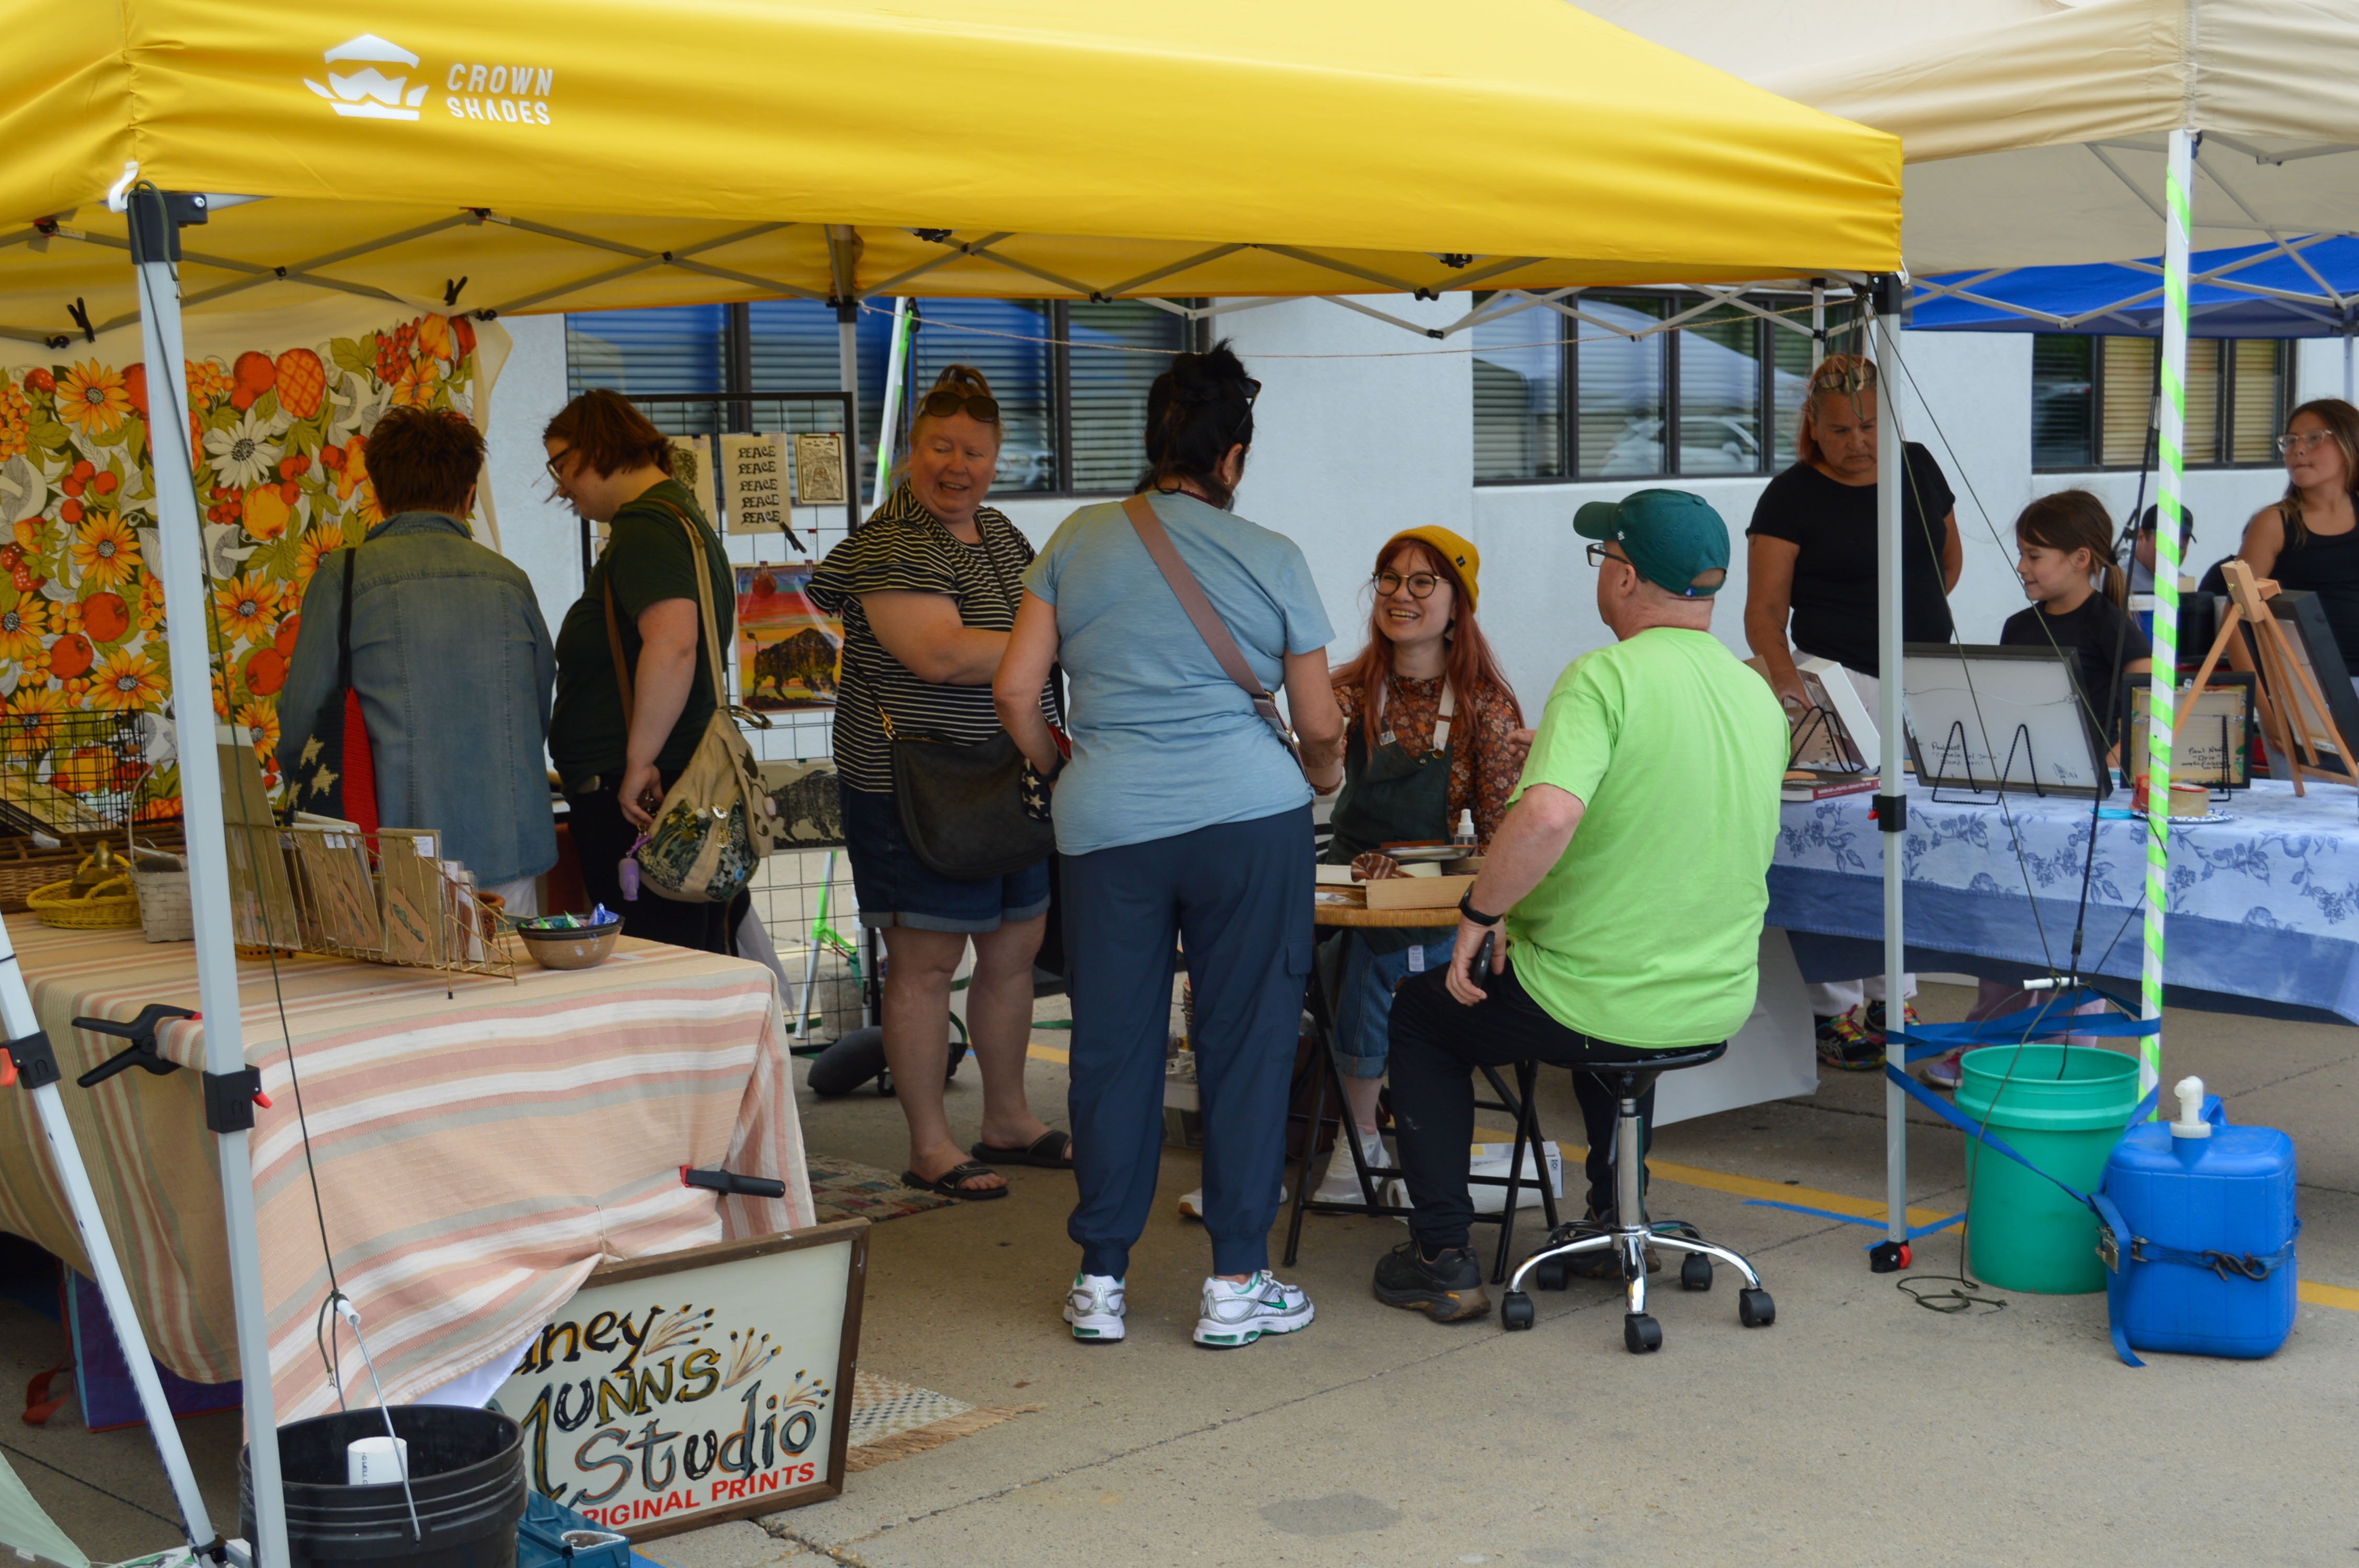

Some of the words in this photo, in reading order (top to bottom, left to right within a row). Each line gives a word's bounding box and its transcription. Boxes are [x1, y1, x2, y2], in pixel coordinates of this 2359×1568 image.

[446, 63, 553, 96] CROWN
[446, 97, 551, 125] SHADES
[737, 445, 776, 459] PEACE
[737, 461, 776, 476] PEACE
[739, 478, 777, 492] PEACE
[741, 494, 780, 509] PEACE
[741, 510, 781, 526] PEACE
[511, 1305, 666, 1379] ney
[568, 1379, 817, 1509] Studio
[582, 1489, 701, 1527] RIGINAL
[712, 1462, 815, 1502] PRINTS
